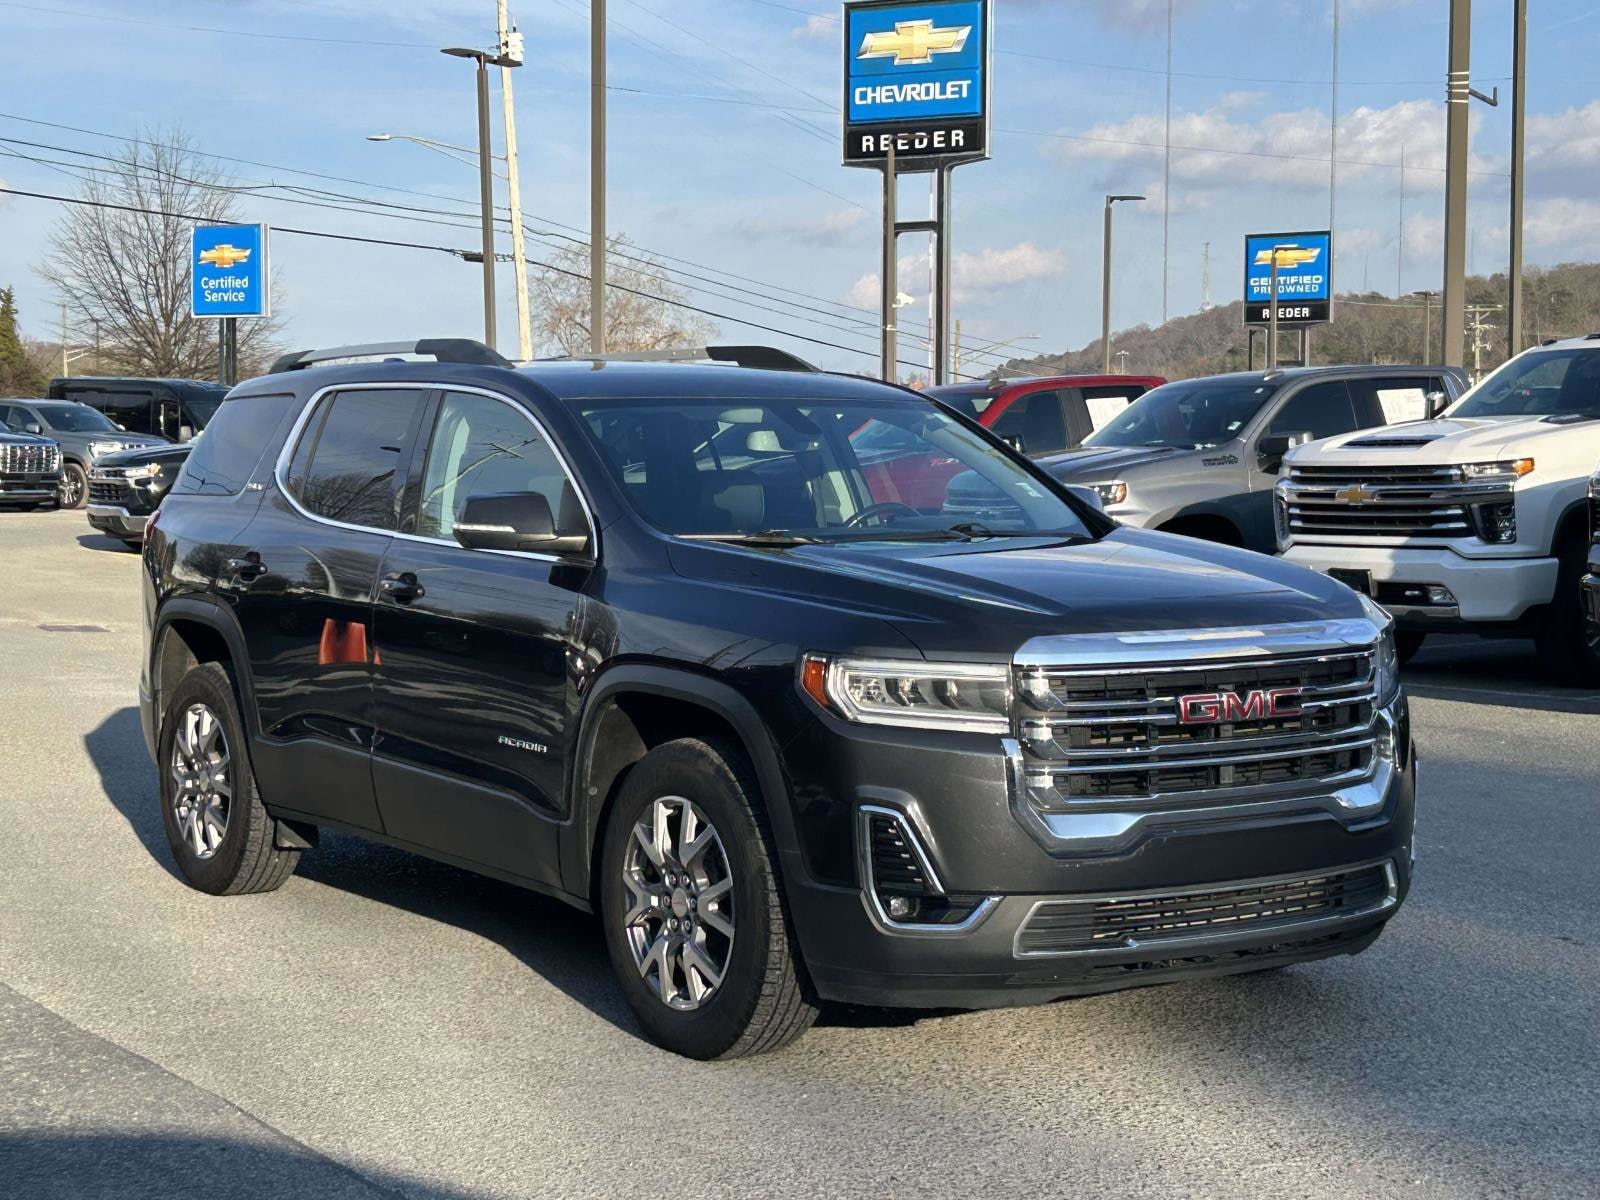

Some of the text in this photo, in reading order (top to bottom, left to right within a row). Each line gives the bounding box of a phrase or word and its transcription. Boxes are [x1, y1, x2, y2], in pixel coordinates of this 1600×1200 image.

[854, 79, 972, 105] CHEVROLET
[201, 275, 249, 289] Certified
[204, 289, 246, 302] Service
[1262, 307, 1310, 319] REDER
[1178, 686, 1302, 724] GMC
[497, 735, 548, 753] ACADIA
